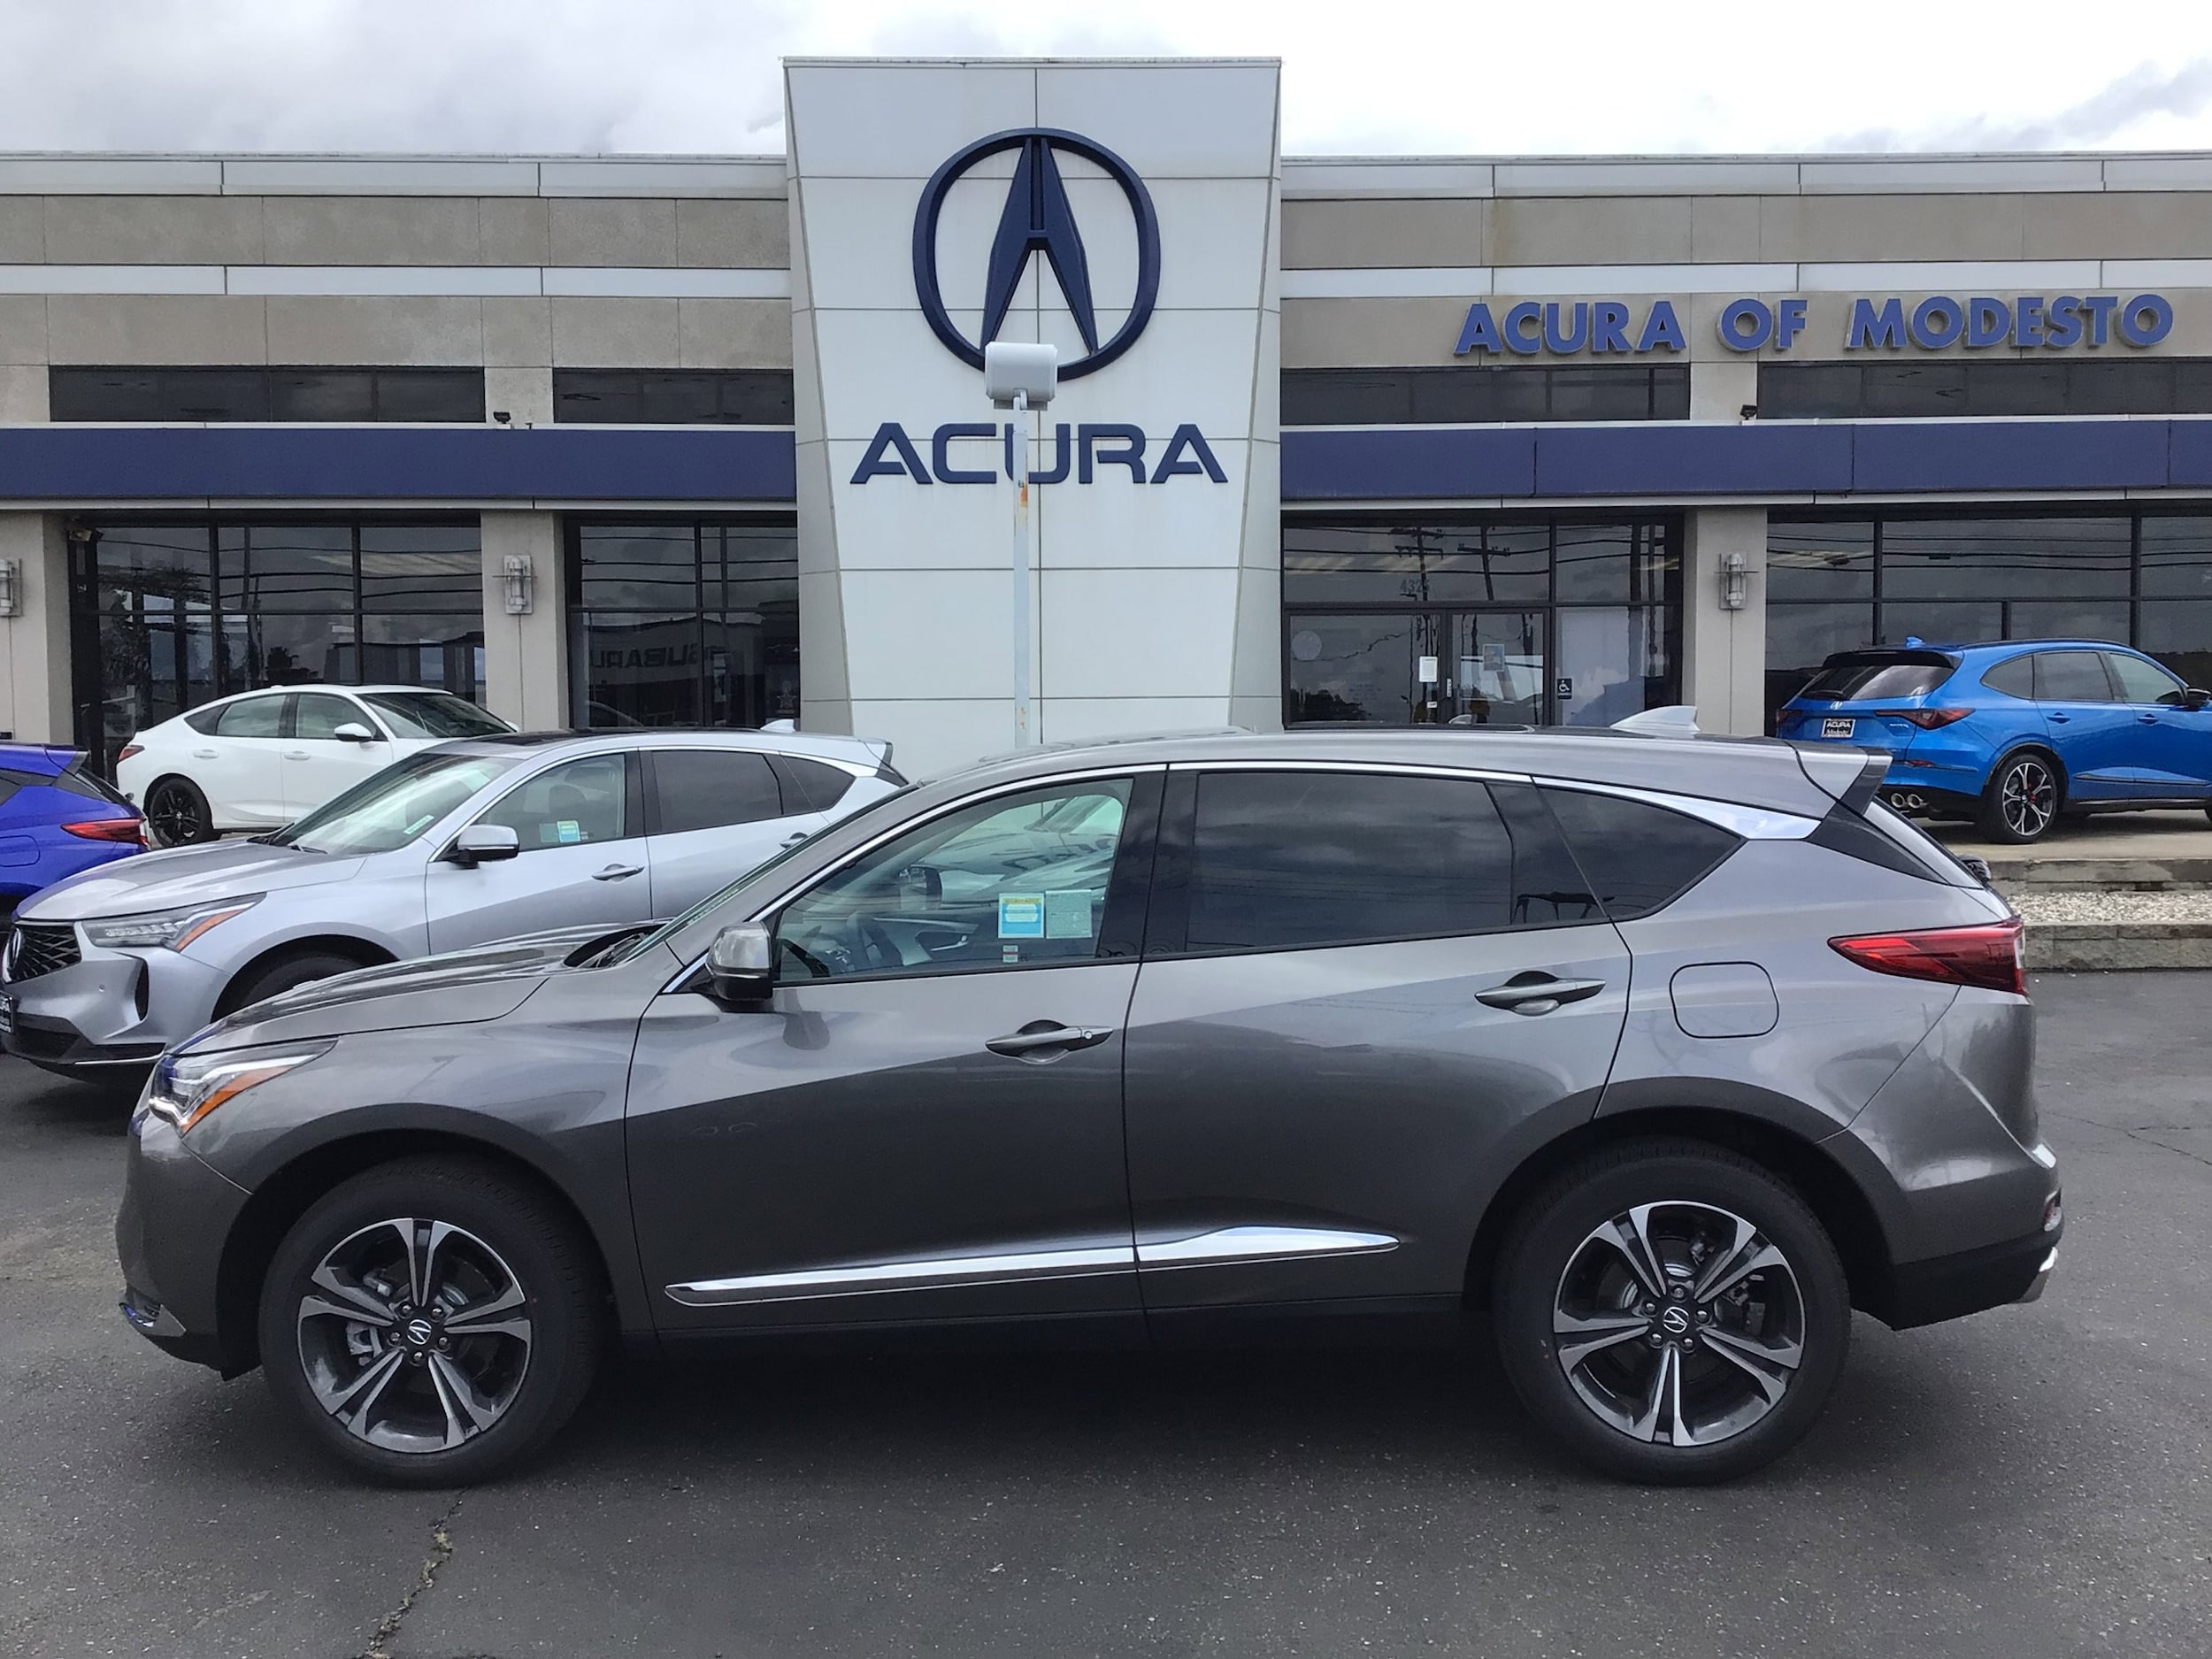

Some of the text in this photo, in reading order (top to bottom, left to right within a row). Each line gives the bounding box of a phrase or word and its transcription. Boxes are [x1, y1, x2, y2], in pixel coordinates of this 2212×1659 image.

[1454, 295, 2174, 353] ACURA OF MODESTO
[849, 422, 1228, 485] ACURA
